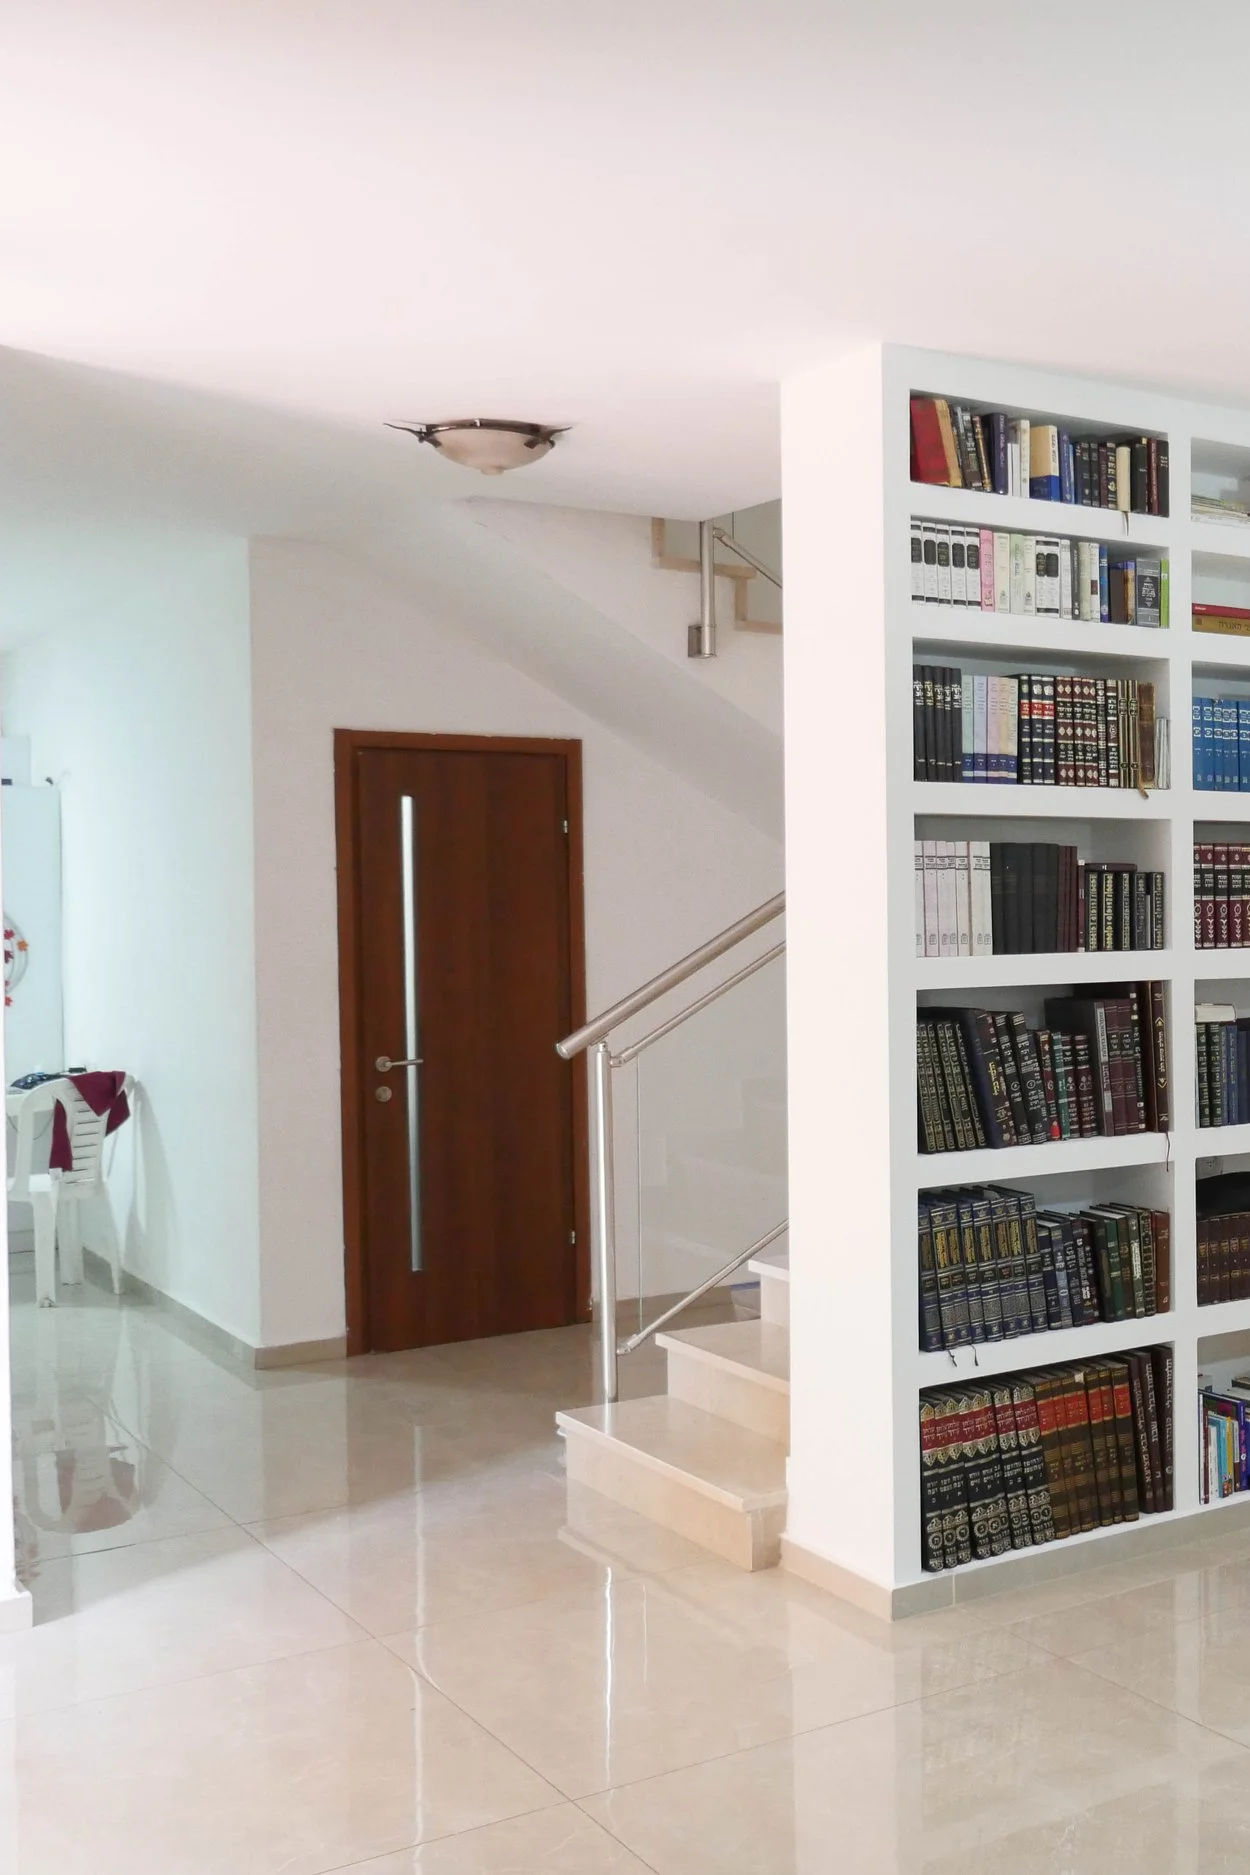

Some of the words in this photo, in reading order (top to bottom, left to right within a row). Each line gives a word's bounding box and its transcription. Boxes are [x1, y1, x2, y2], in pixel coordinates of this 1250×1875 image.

[1145, 1363, 1154, 1391] תלמוד
[1165, 1358, 1173, 1386] תלמוד
[1148, 1391, 1156, 1413] בבלי
[1165, 1387, 1173, 1409] בבלי
